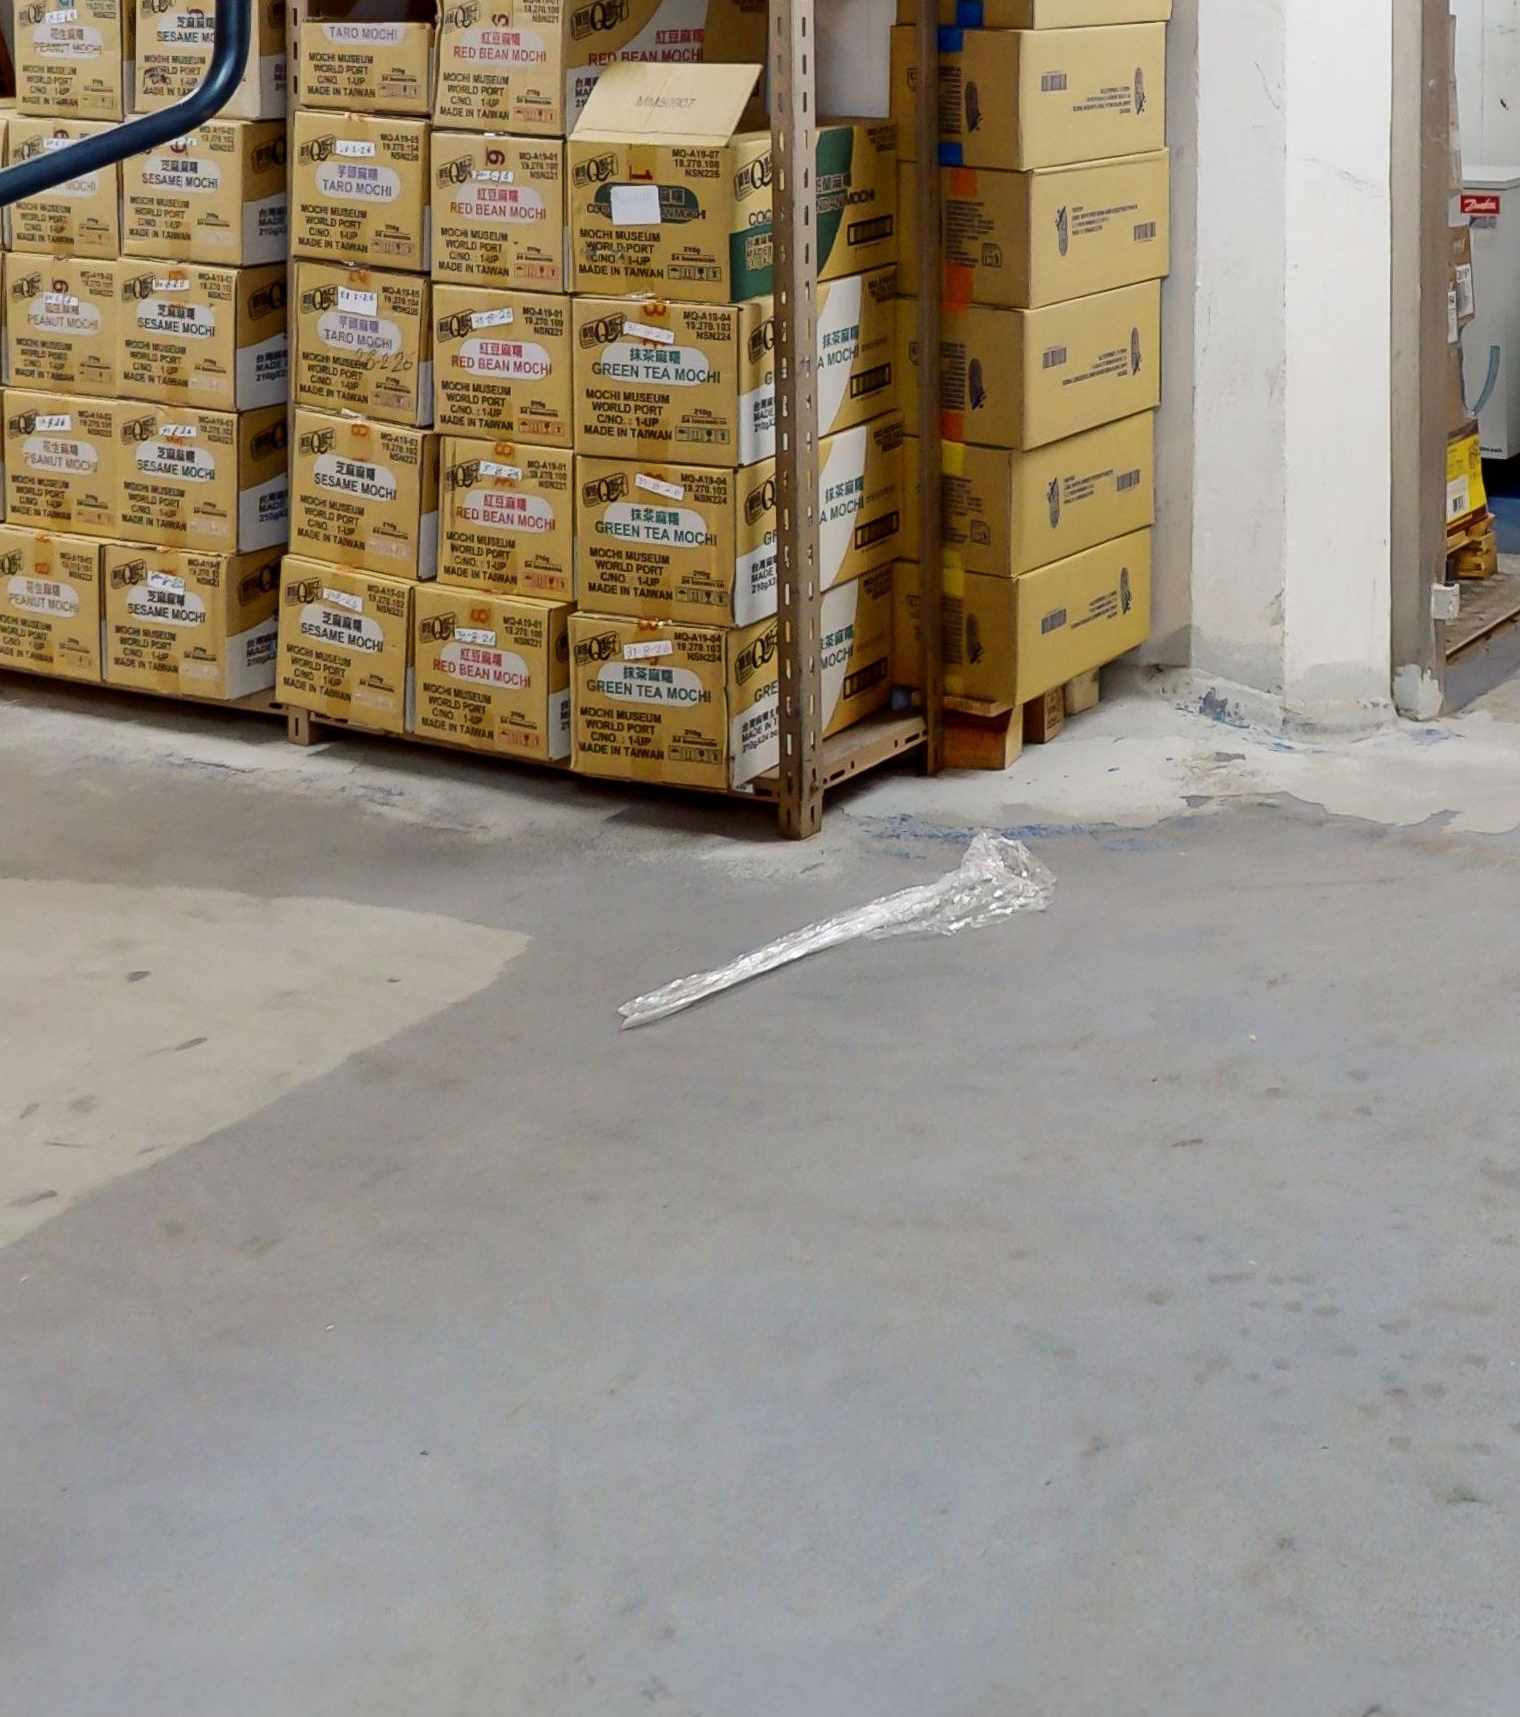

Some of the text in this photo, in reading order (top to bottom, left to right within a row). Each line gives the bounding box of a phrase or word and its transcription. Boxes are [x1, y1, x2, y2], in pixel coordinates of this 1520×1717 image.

[453, 46, 547, 62] RED BEAN MOCHI
[592, 362, 720, 384] GREEN TEA MOCHI
[585, 389, 670, 404] MOCHI MUSEUM
[592, 401, 663, 415] WORLD PORT
[584, 425, 672, 441] MADE IN TAIWAN
[314, 472, 397, 501] SESAME MOCHI
